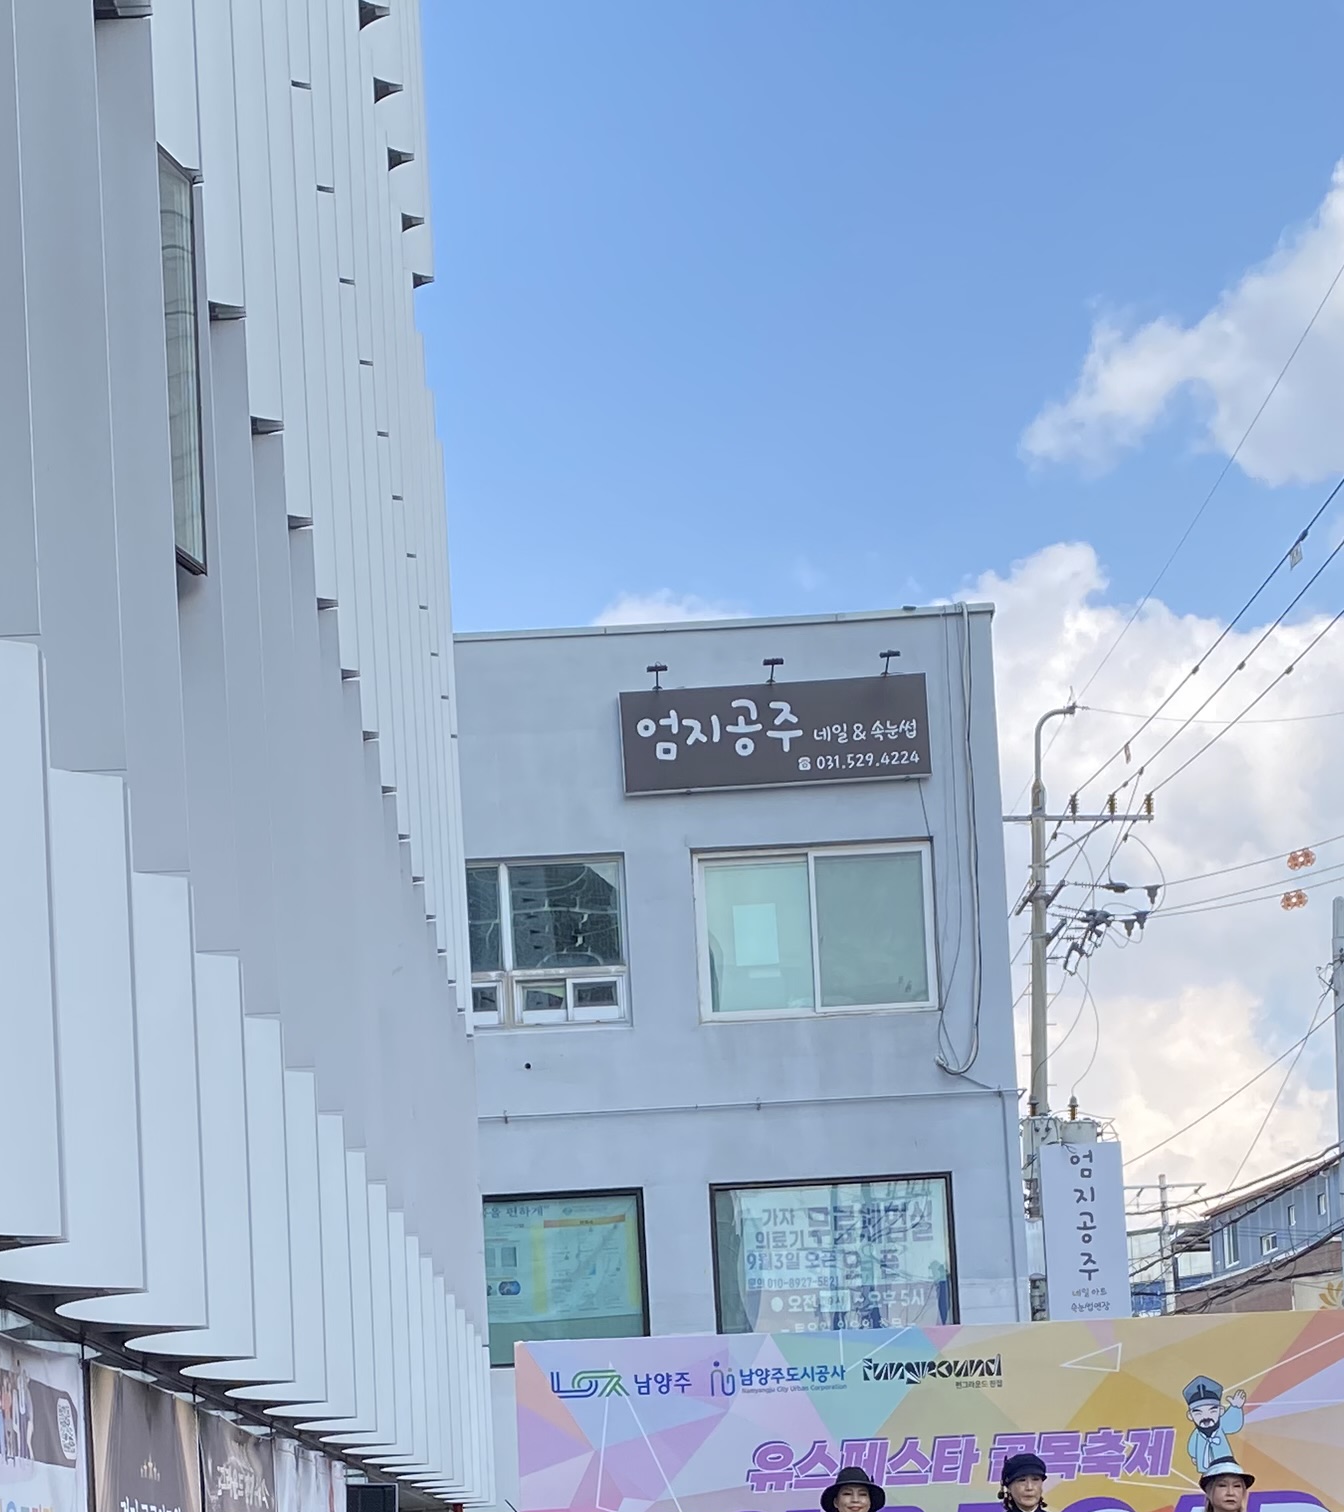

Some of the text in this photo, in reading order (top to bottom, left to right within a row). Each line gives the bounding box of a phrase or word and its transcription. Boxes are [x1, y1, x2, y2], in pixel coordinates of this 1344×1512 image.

[636, 698, 917, 761] 엄지공주 네일 & 속눈썹
[816, 750, 920, 771] 031.529.4224
[1070, 1149, 1099, 1281] 엄지공주
[755, 1230, 805, 1251] 의료기
[788, 1295, 818, 1313] 오전
[900, 1288, 925, 1307] 5시
[634, 1364, 846, 1396] 남양주 남양주도시공사
